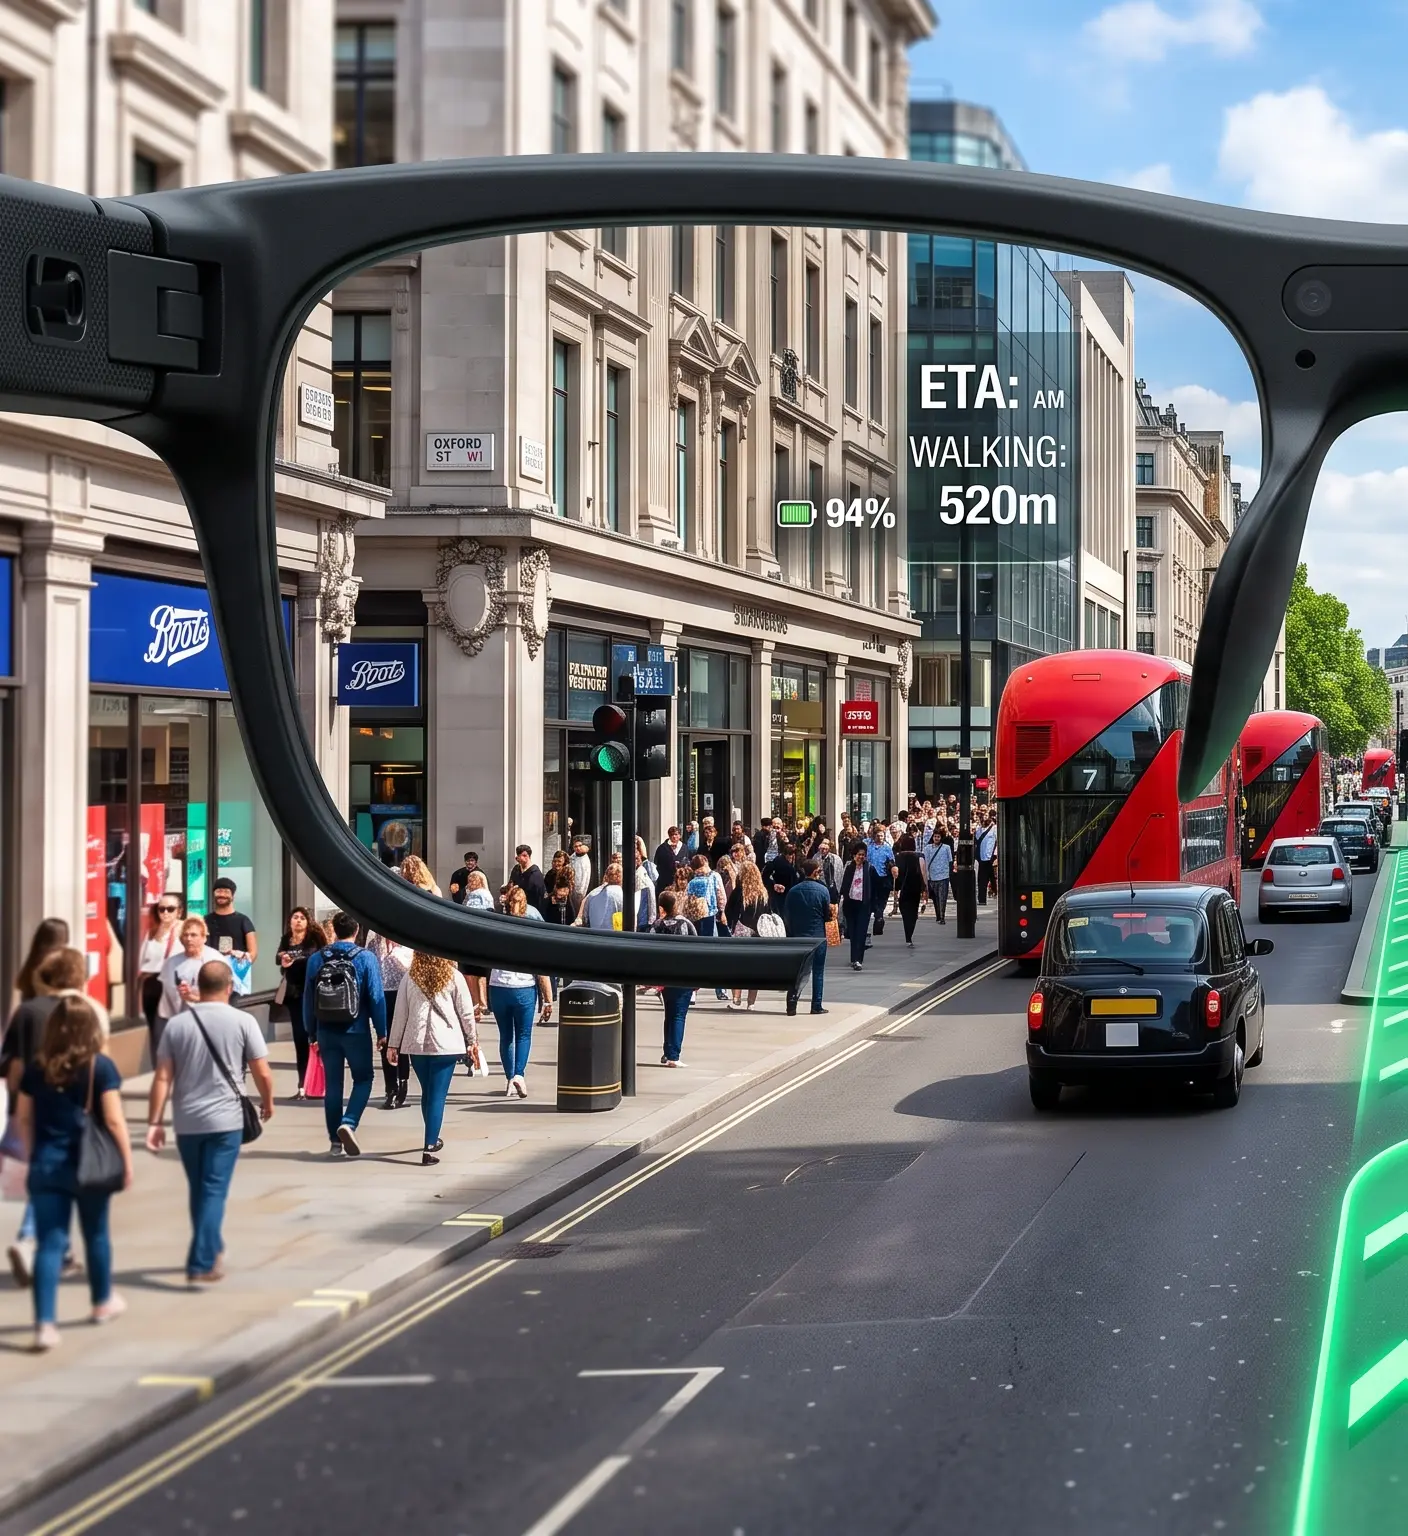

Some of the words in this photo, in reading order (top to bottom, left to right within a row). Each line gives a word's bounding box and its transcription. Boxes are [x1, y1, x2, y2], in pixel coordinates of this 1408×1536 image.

[920, 364, 1019, 409] ETA:
[1033, 390, 1065, 409] AM
[433, 437, 482, 450] OXFORD
[435, 451, 452, 463] ST
[466, 451, 483, 463] W1
[908, 435, 1067, 469] WALKING:
[826, 496, 897, 530] 94%
[938, 484, 1058, 526] 520m
[1082, 769, 1098, 791] 7
